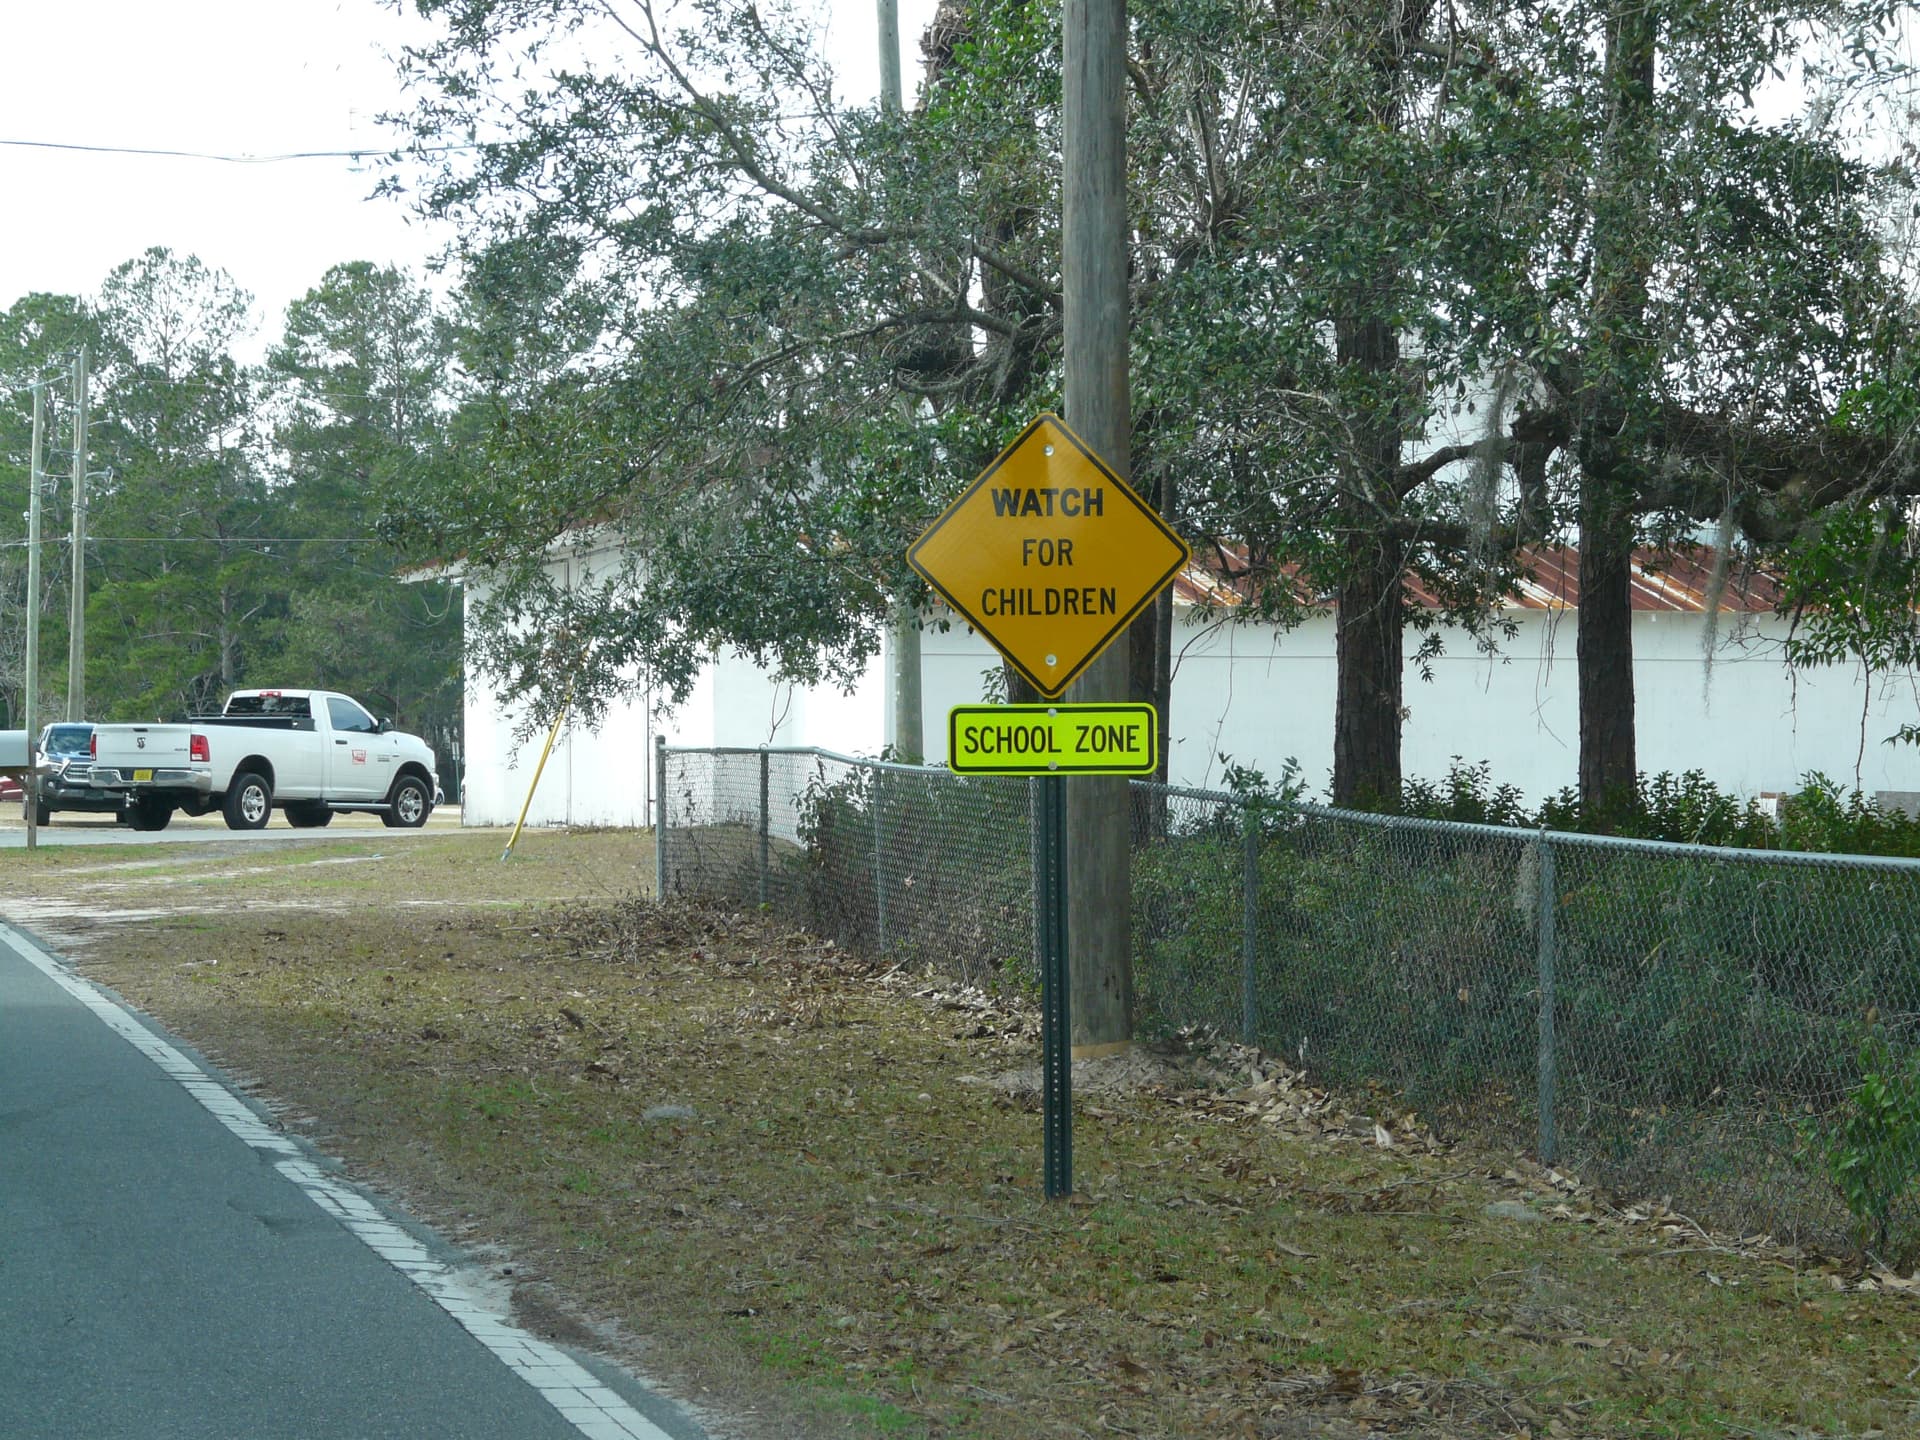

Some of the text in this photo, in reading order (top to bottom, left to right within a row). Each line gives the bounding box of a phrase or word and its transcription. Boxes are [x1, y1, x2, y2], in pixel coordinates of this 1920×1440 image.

[991, 488, 1103, 517] WATCH
[1022, 538, 1073, 566] FOR
[981, 587, 1116, 616] CHILDREN
[964, 725, 1140, 754] SCHOOL ZONE
